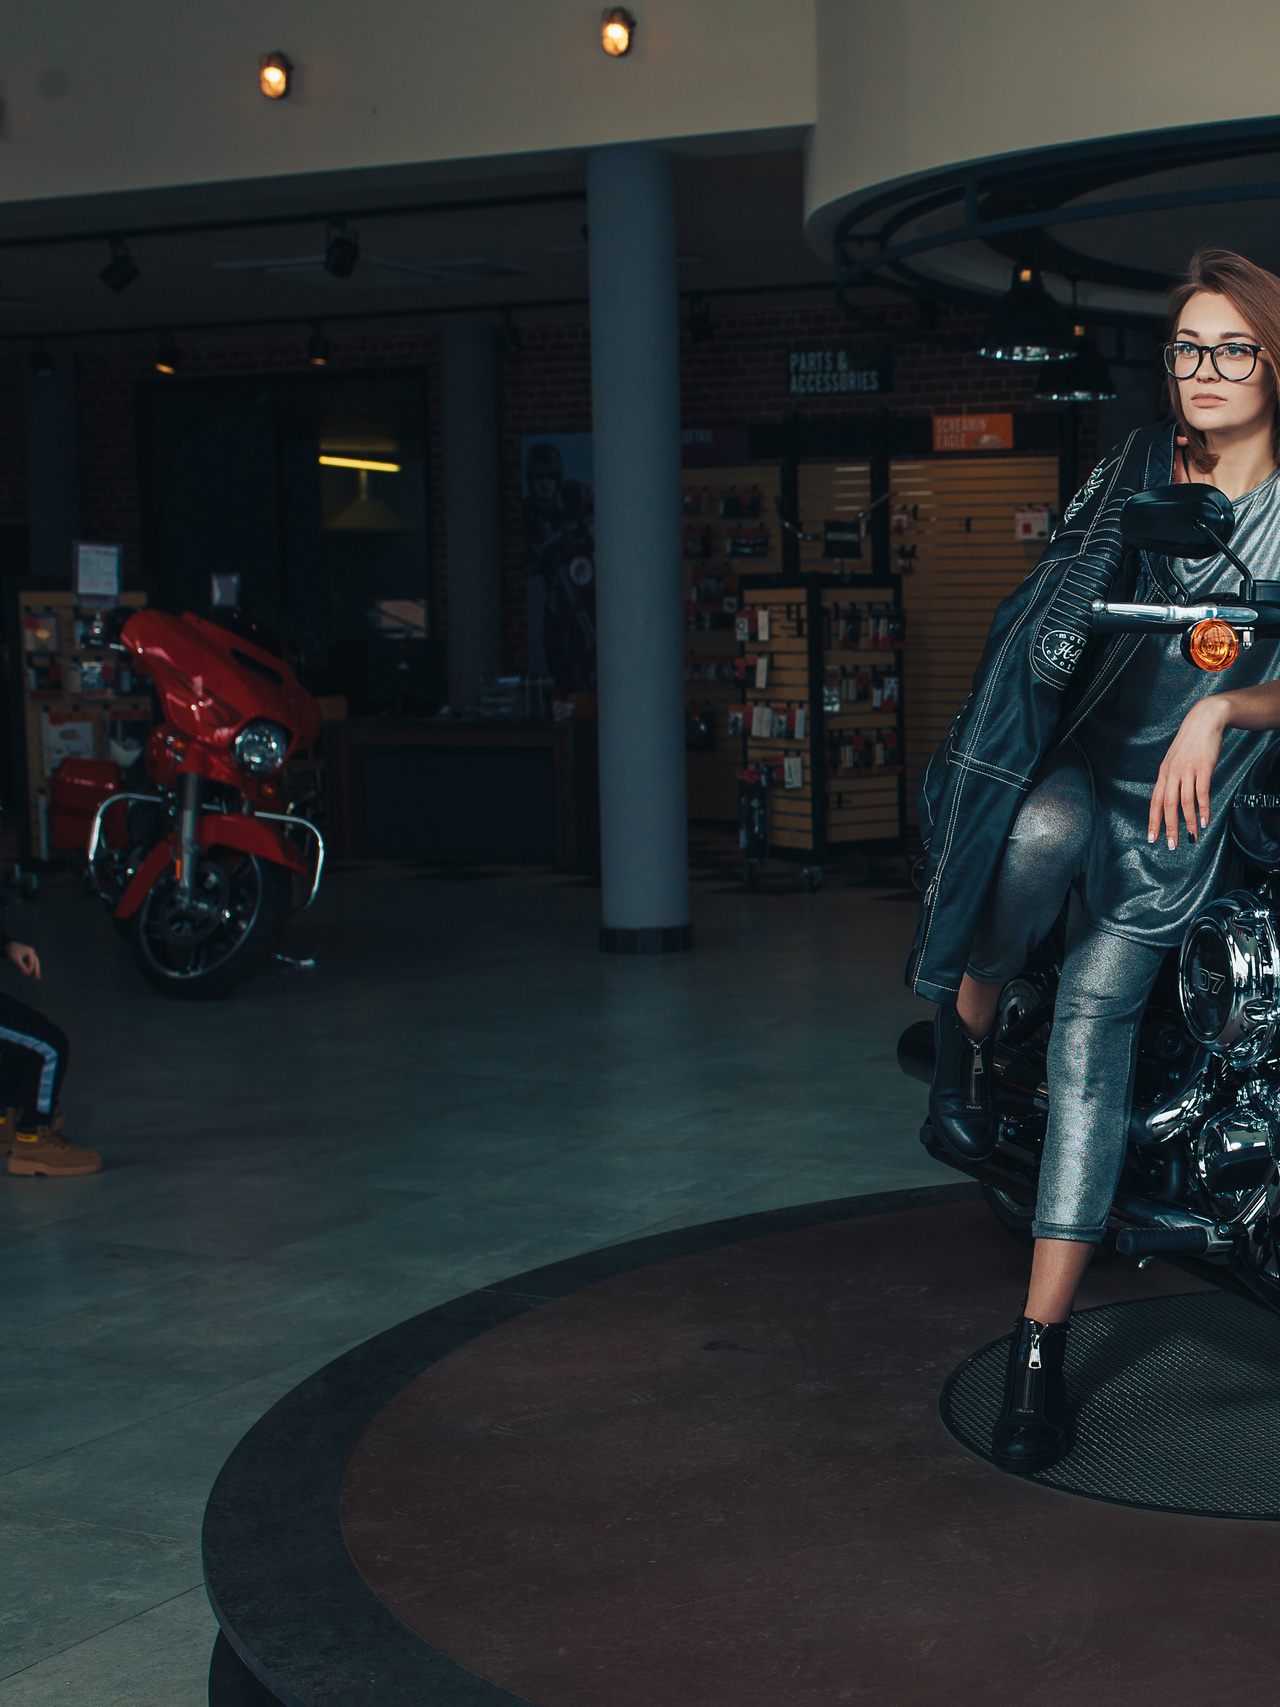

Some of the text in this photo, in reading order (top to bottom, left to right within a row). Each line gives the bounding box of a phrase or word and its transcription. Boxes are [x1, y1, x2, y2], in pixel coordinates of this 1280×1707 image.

[790, 350, 849, 374] PARTS &
[790, 371, 879, 394] ACCESSORIES
[936, 432, 966, 450] EAGLE
